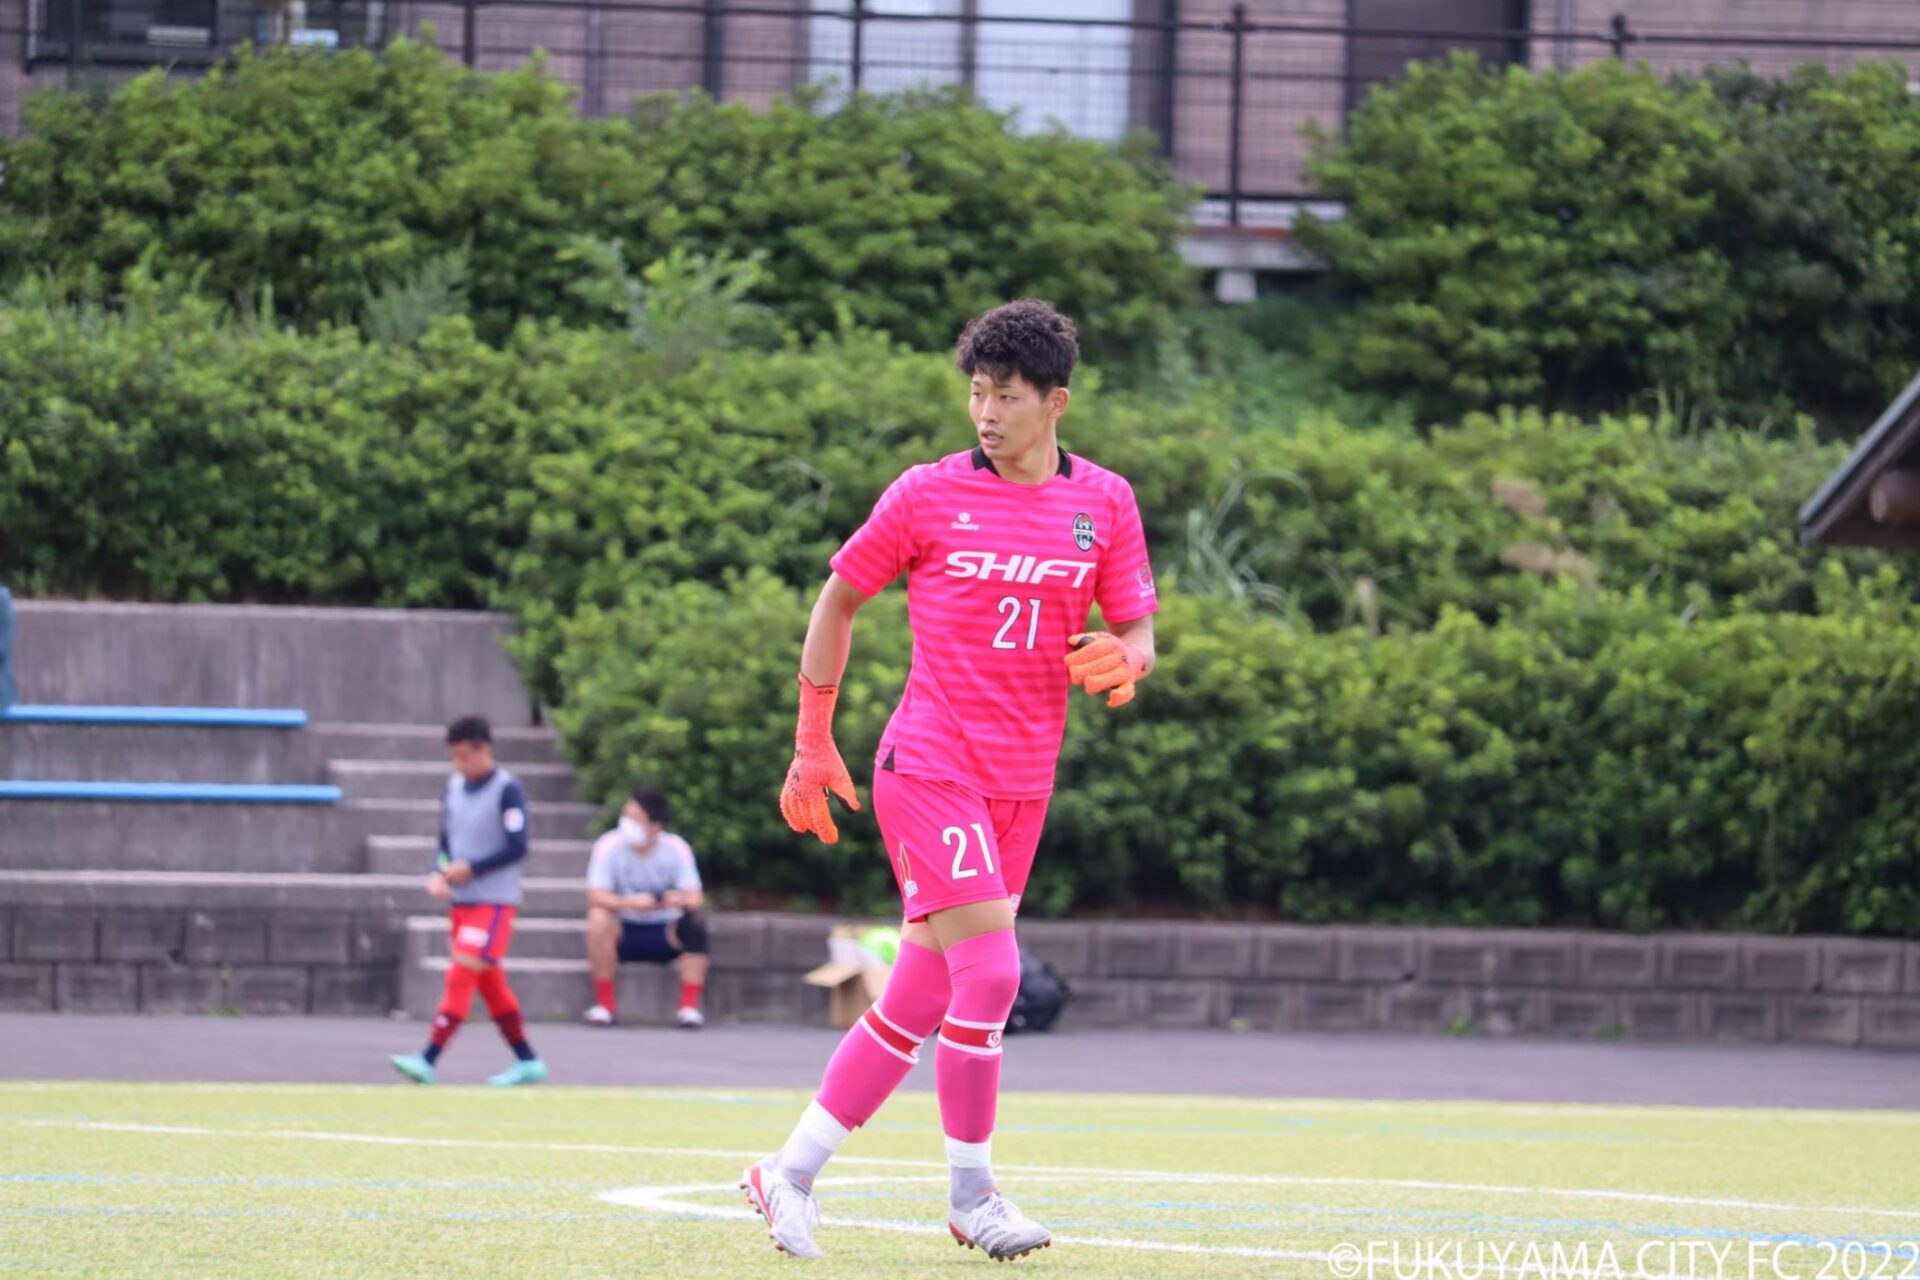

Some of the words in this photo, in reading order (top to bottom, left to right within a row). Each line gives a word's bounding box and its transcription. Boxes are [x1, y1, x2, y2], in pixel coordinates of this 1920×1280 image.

[945, 551, 1096, 588] SHIFT
[992, 596, 1041, 650] 21
[942, 823, 995, 880] 21
